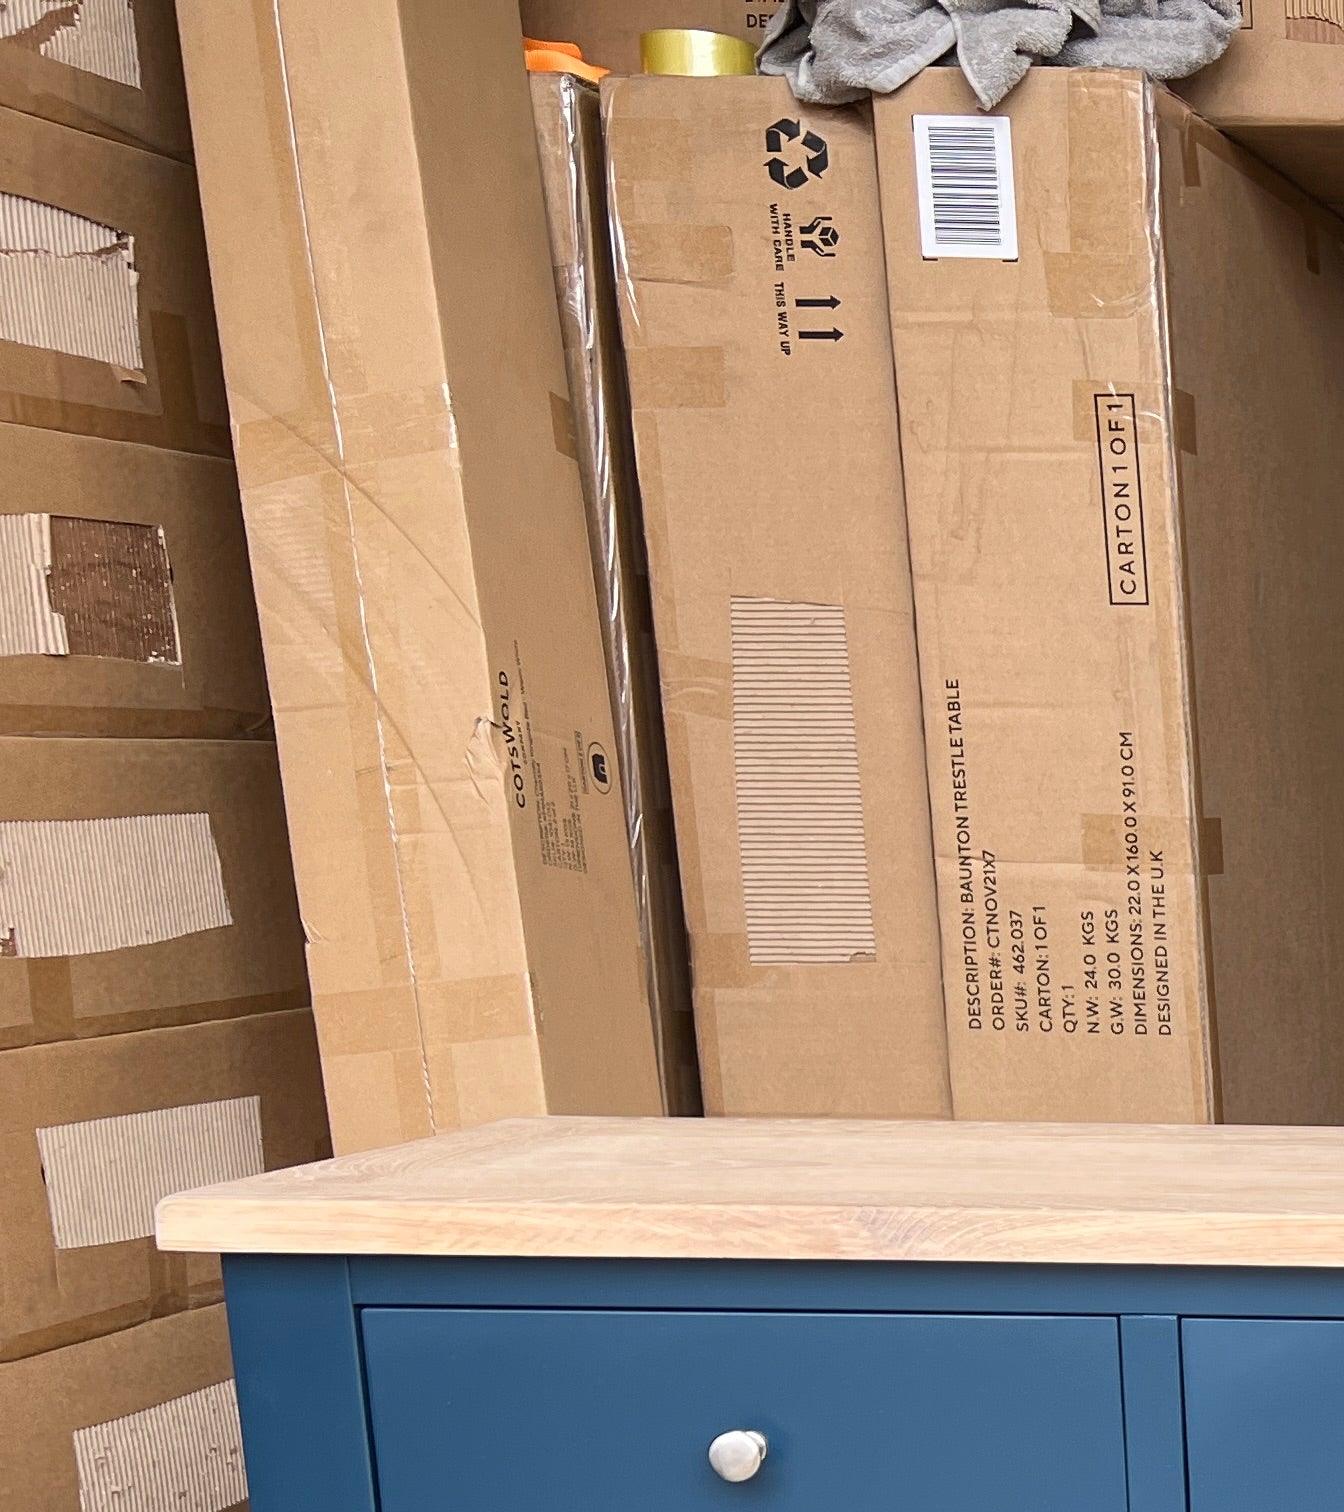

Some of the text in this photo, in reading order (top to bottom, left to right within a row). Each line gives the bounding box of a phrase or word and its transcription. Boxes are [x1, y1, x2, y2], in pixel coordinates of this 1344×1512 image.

[747, 14, 774, 28] DE
[770, 204, 784, 271] WITH CARE
[783, 213, 795, 261] HANDLE
[774, 282, 790, 356] THIS WAY UP
[1108, 420, 1127, 455] OF
[1113, 483, 1136, 595] CARTON
[499, 671, 525, 808] COTSWOLD
[946, 679, 981, 1030] DESCRIPTION: BAUNTON TRESTLE TABLE
[1119, 732, 1147, 1035] DIMENSIONS: 22.0 X 160.0 X 91.0 CM
[982, 850, 1005, 1030] ORDER#: CTNOV21X7
[1010, 910, 1029, 1032] SKU#: 462.037
[1033, 915, 1047, 940] OF
[1081, 911, 1100, 1033] N.W: 24.0 KGS
[1105, 909, 1124, 1034] G.W: 30.0 KGS
[1150, 850, 1171, 1036] DESIGNED IN THE U.K
[1036, 954, 1052, 1032] CARTON:
[1062, 994, 1077, 1033] QTY:
